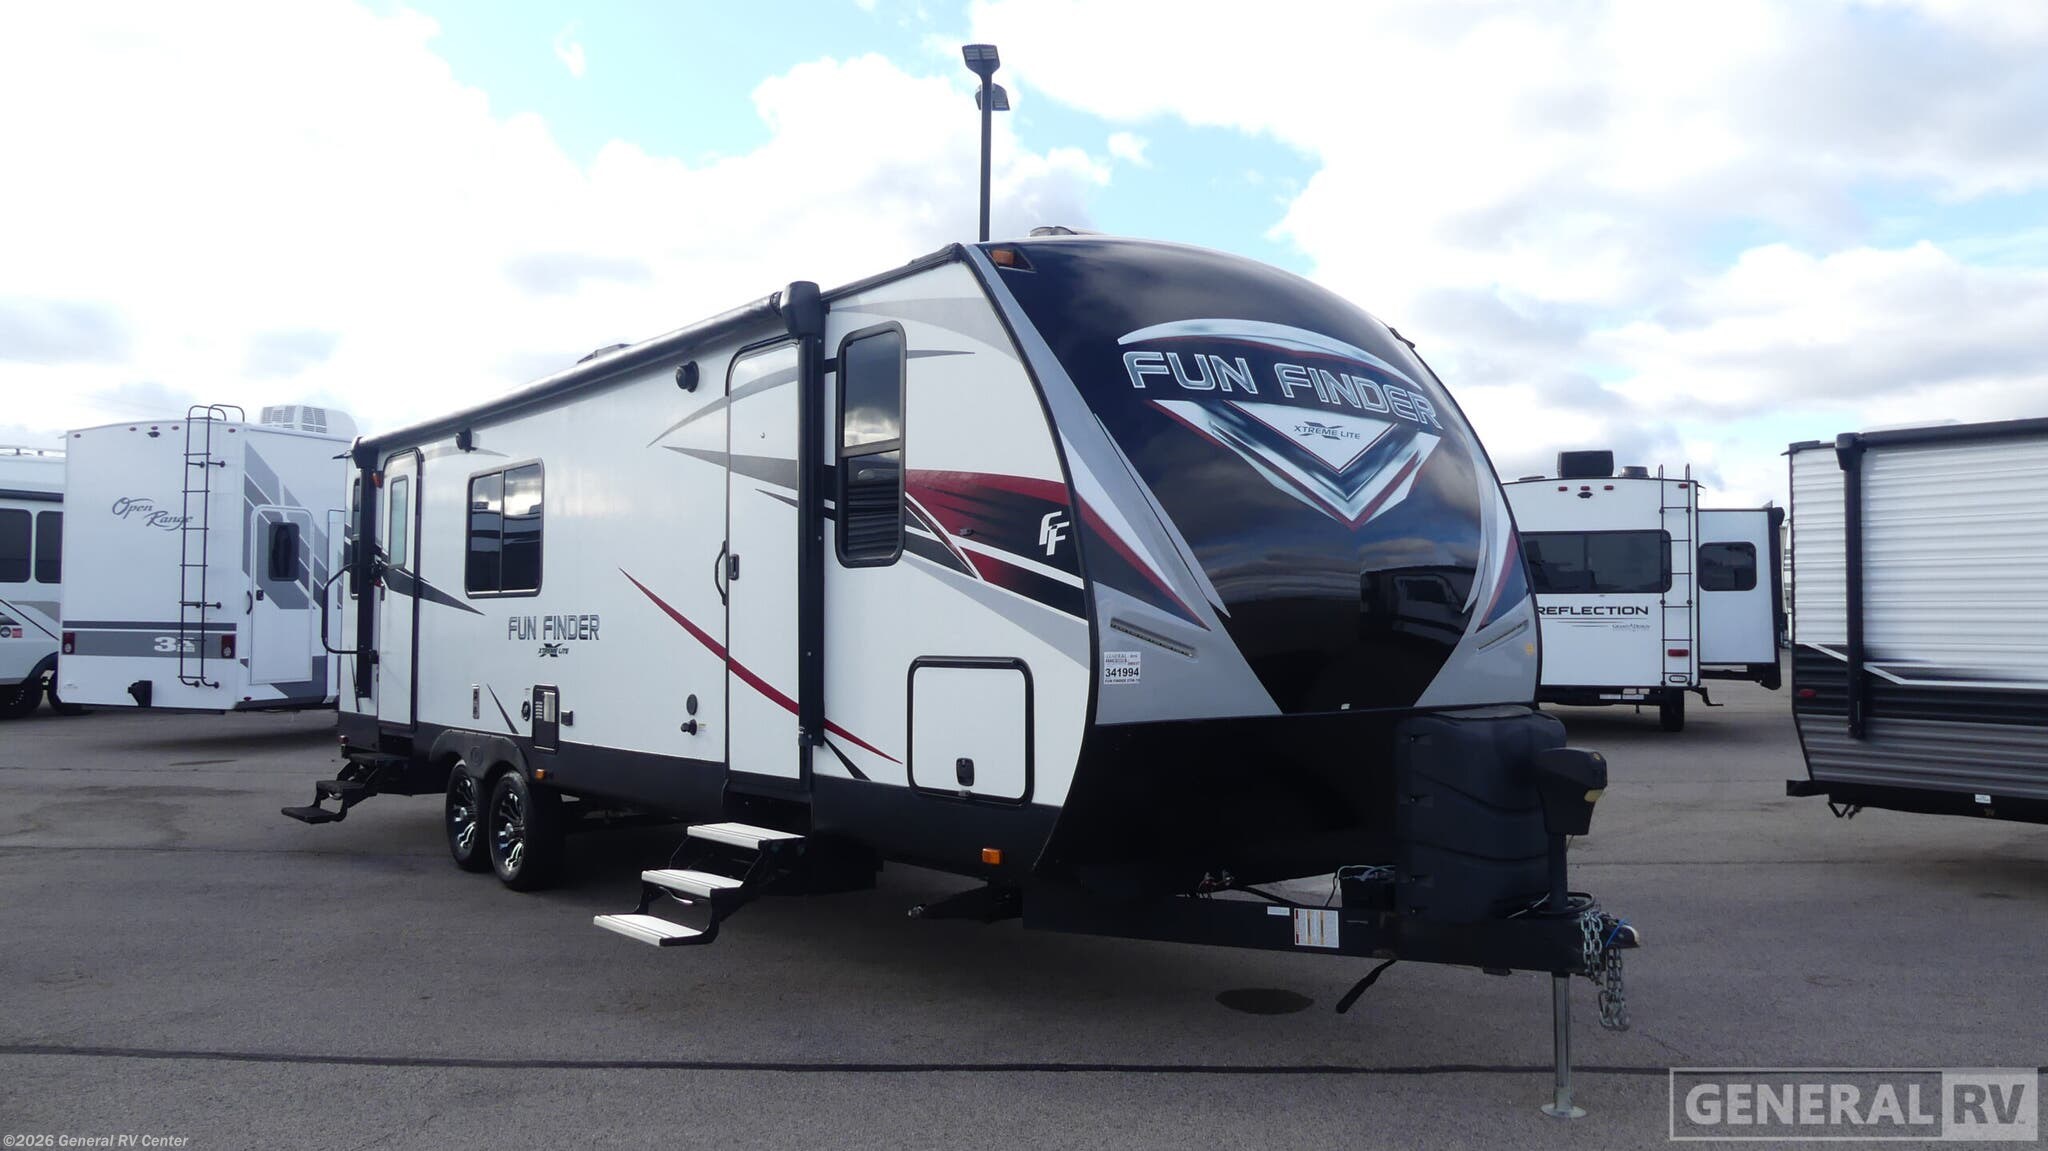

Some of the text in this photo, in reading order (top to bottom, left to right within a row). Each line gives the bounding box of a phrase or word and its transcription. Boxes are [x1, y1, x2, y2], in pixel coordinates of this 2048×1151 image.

[1123, 351, 1444, 431] FUN FINDER
[1294, 425, 1361, 440] XTREME LITE
[112, 497, 154, 520] Open
[144, 510, 194, 531] Range
[1039, 510, 1070, 556] FF
[1537, 605, 1649, 616] REFLECTION
[508, 614, 601, 641] FUN FINDER
[1105, 667, 1139, 678] 341994
